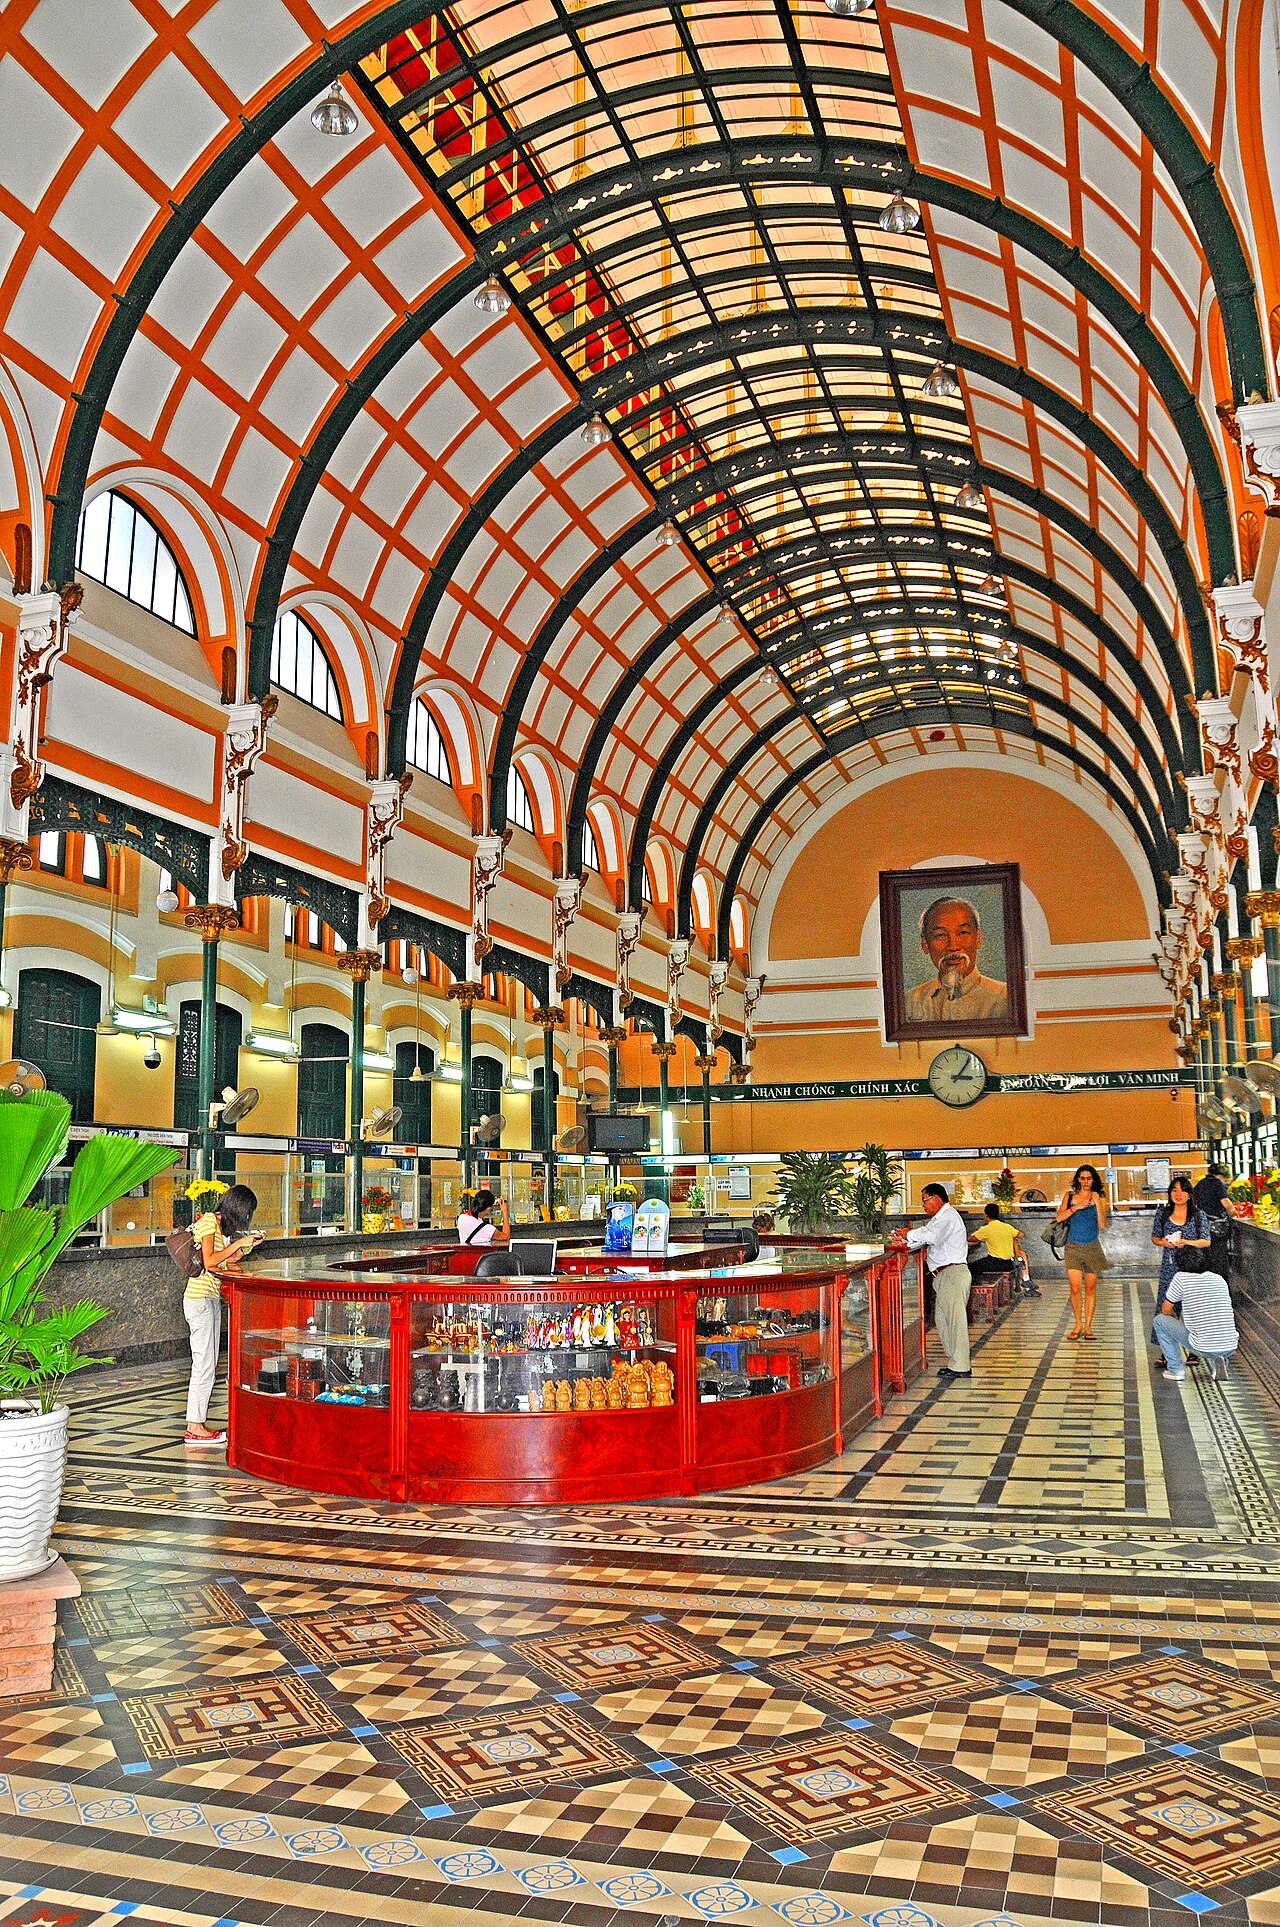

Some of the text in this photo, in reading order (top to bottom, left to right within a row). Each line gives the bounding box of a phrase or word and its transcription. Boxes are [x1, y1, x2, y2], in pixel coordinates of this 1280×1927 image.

[1119, 1073, 1143, 1084] VĂN
[1146, 1073, 1179, 1083] MINH
[795, 1084, 835, 1096] CHÓNG
[850, 1082, 889, 1094] CHÍNH
[894, 1081, 920, 1093] XÁC
